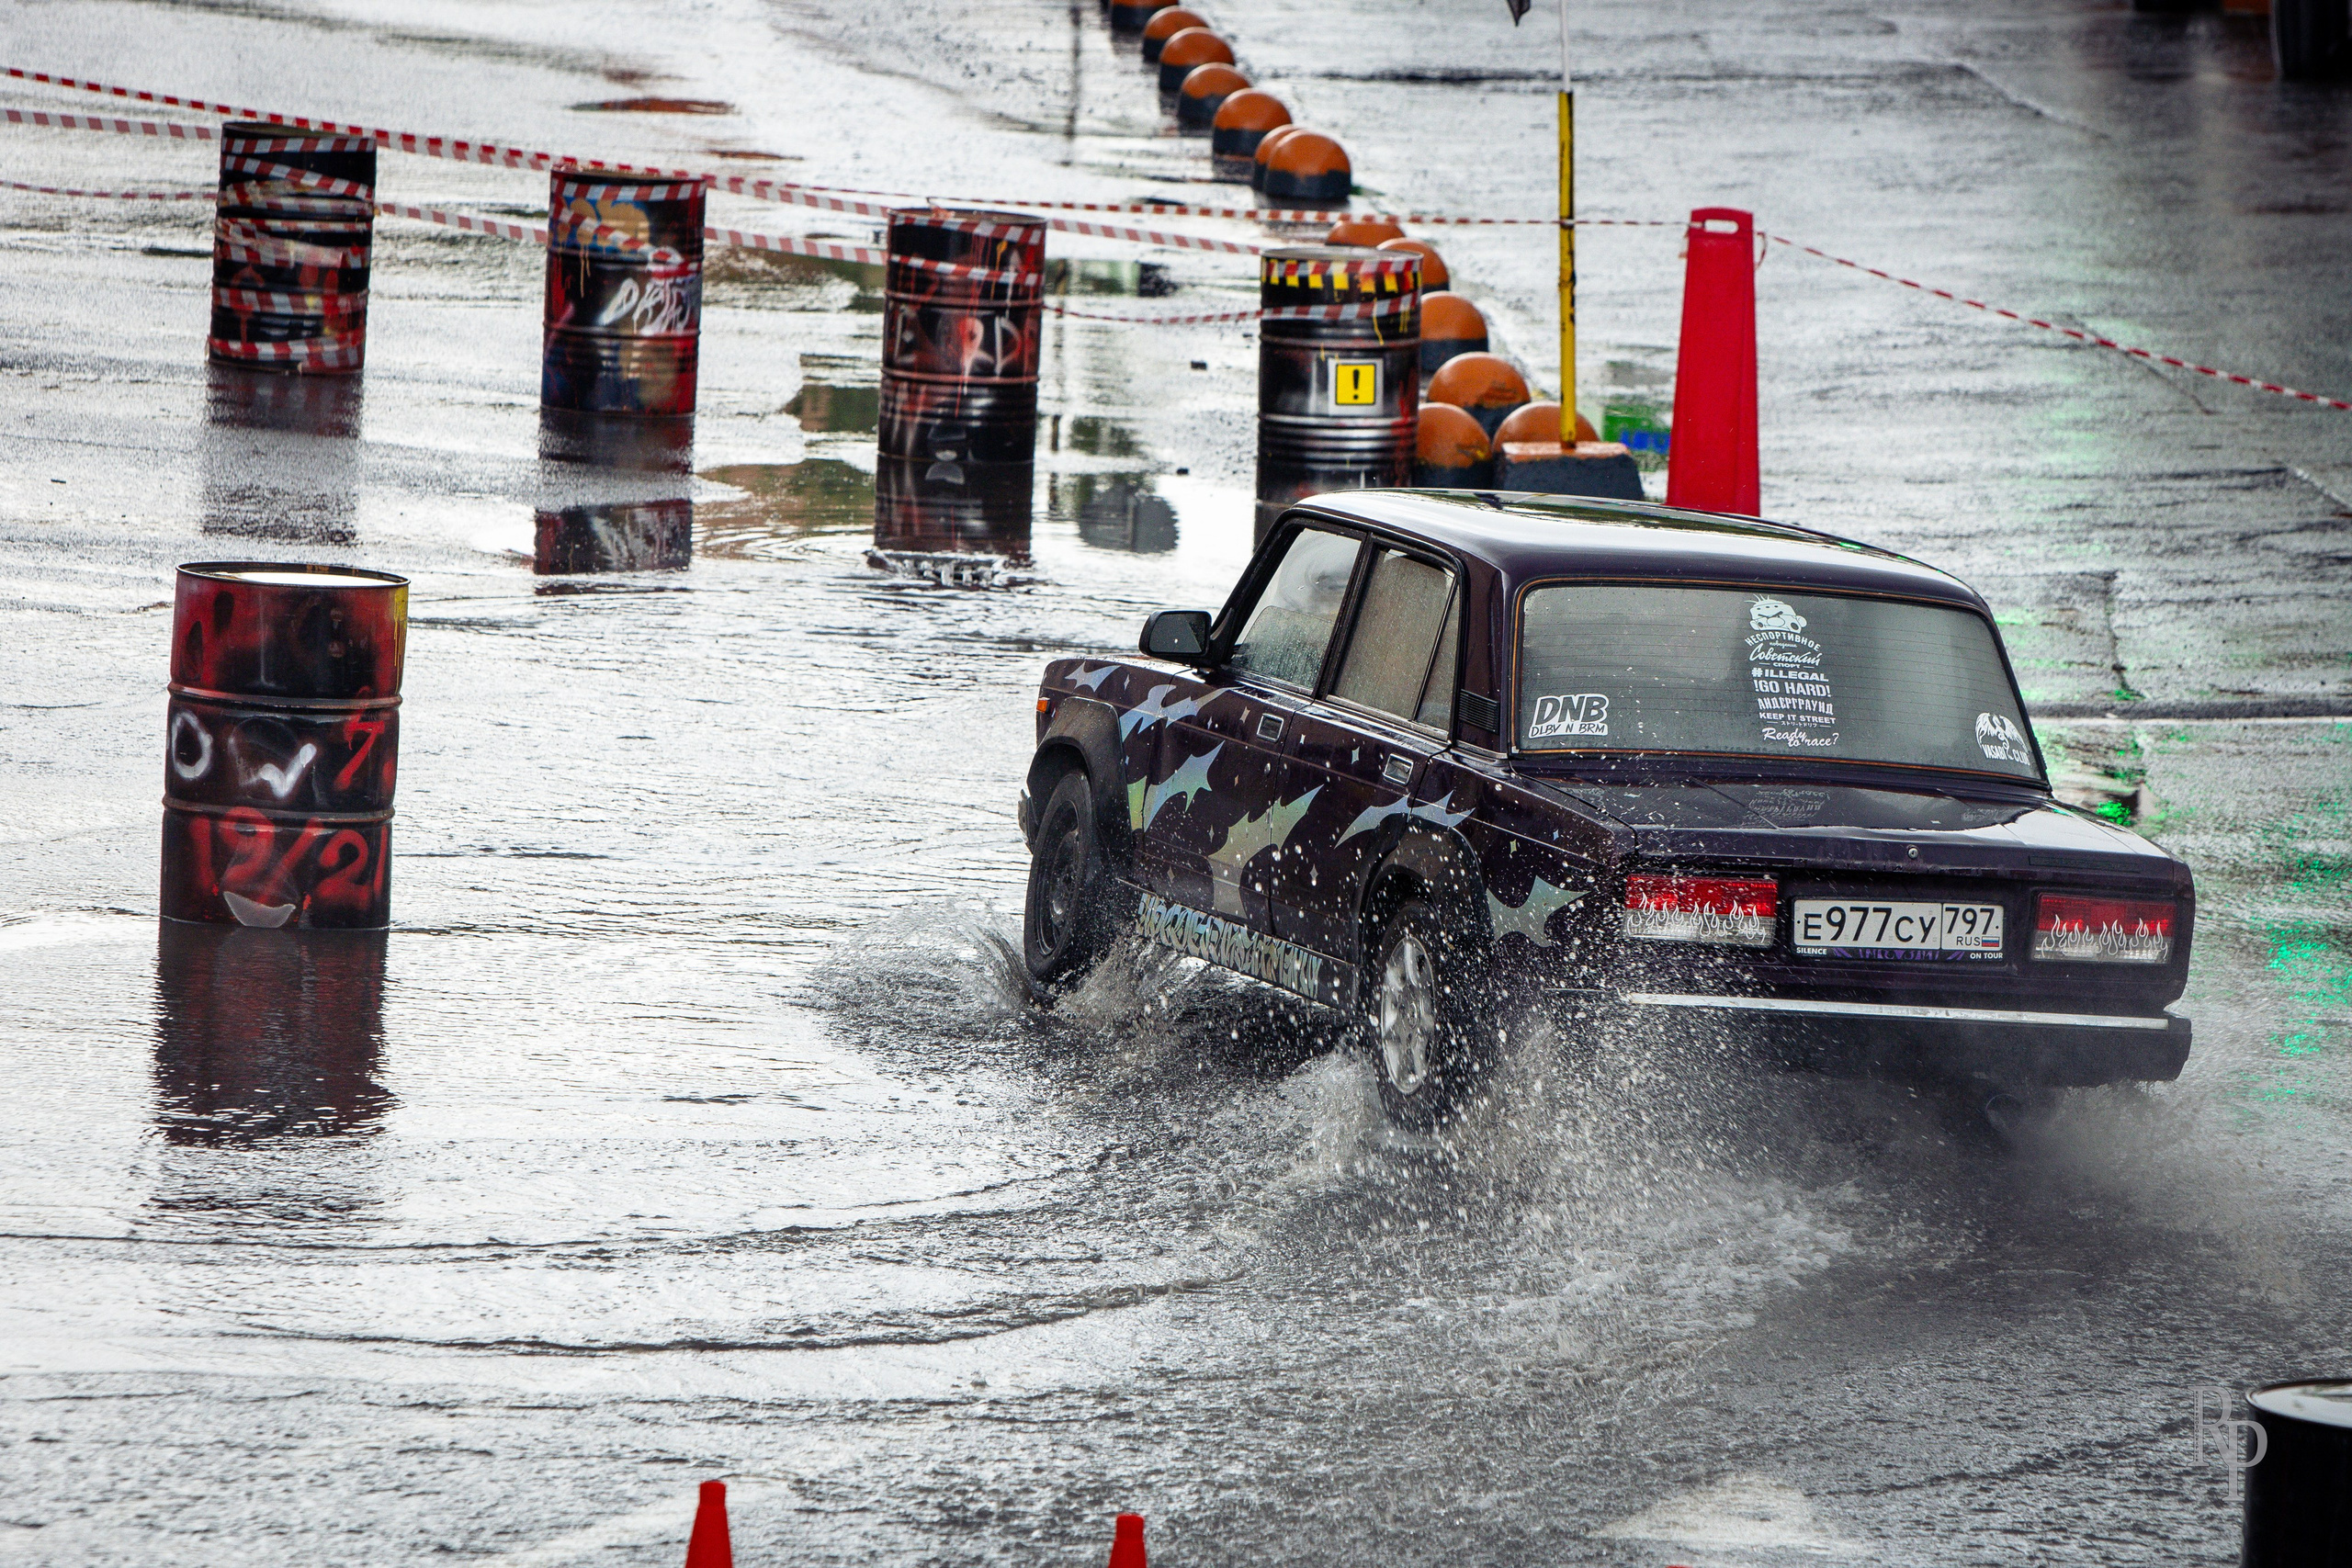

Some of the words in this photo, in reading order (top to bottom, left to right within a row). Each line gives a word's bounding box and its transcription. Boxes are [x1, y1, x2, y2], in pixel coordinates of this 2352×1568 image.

[1745, 631, 1821, 651] НЕСПОРТИВНОЕ
[1749, 643, 1823, 666] Советский
[1751, 667, 1828, 682] #ILLEGAL
[1753, 680, 1780, 694] !GO
[1785, 682, 1831, 697] HARD!
[1533, 694, 1608, 725] DNB
[1758, 696, 1834, 716] АНДЕРГРАУНД
[1759, 712, 1784, 720] KEEP
[1800, 715, 1836, 724] STREET
[1566, 724, 1573, 733] N
[1579, 723, 1605, 733] BRM
[1761, 727, 1807, 743] Ready
[1788, 736, 1801, 747] to
[1804, 732, 1839, 747] race?
[1804, 906, 1936, 942] Е977СУ
[1944, 907, 1995, 935] 797
[1956, 936, 1981, 946] RUS
[1796, 947, 1826, 955] SILENCE
